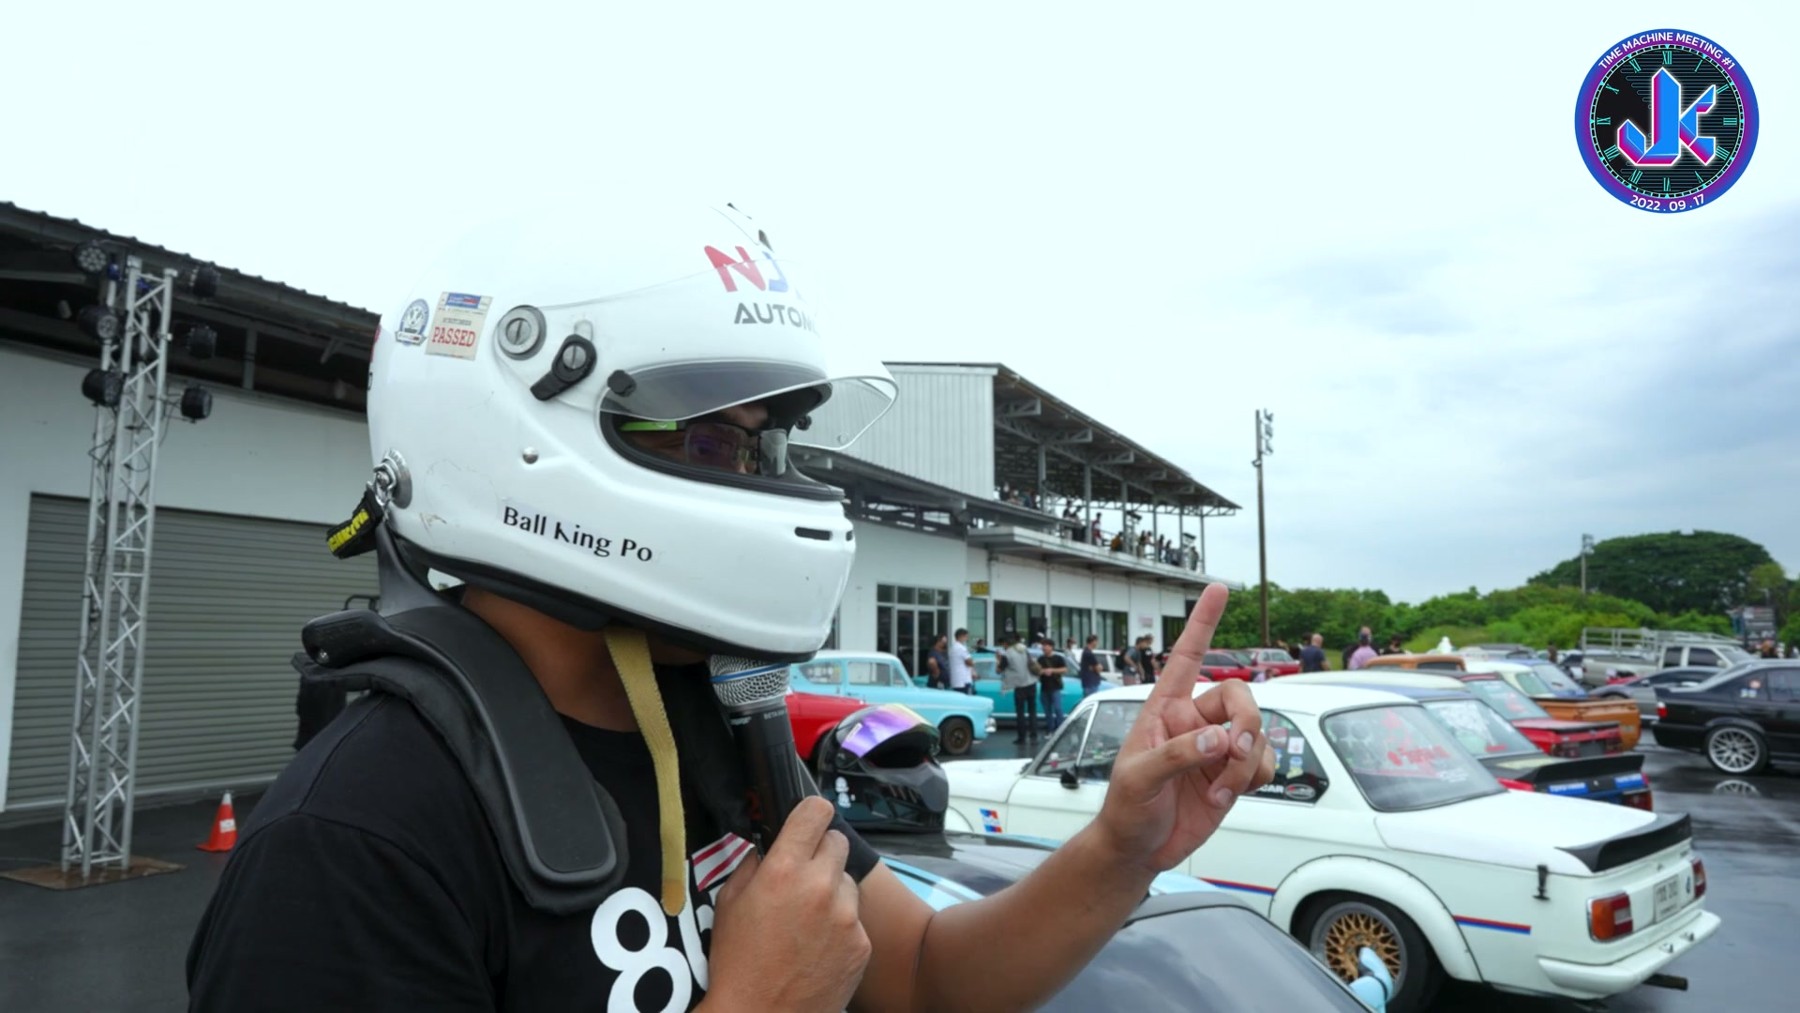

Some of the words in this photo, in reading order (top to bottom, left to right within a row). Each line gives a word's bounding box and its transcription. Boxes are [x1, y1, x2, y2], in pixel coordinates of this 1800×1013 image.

[432, 326, 476, 348] PASSED
[503, 506, 547, 536] Ball
[554, 521, 612, 557] King
[620, 538, 653, 562] Po
